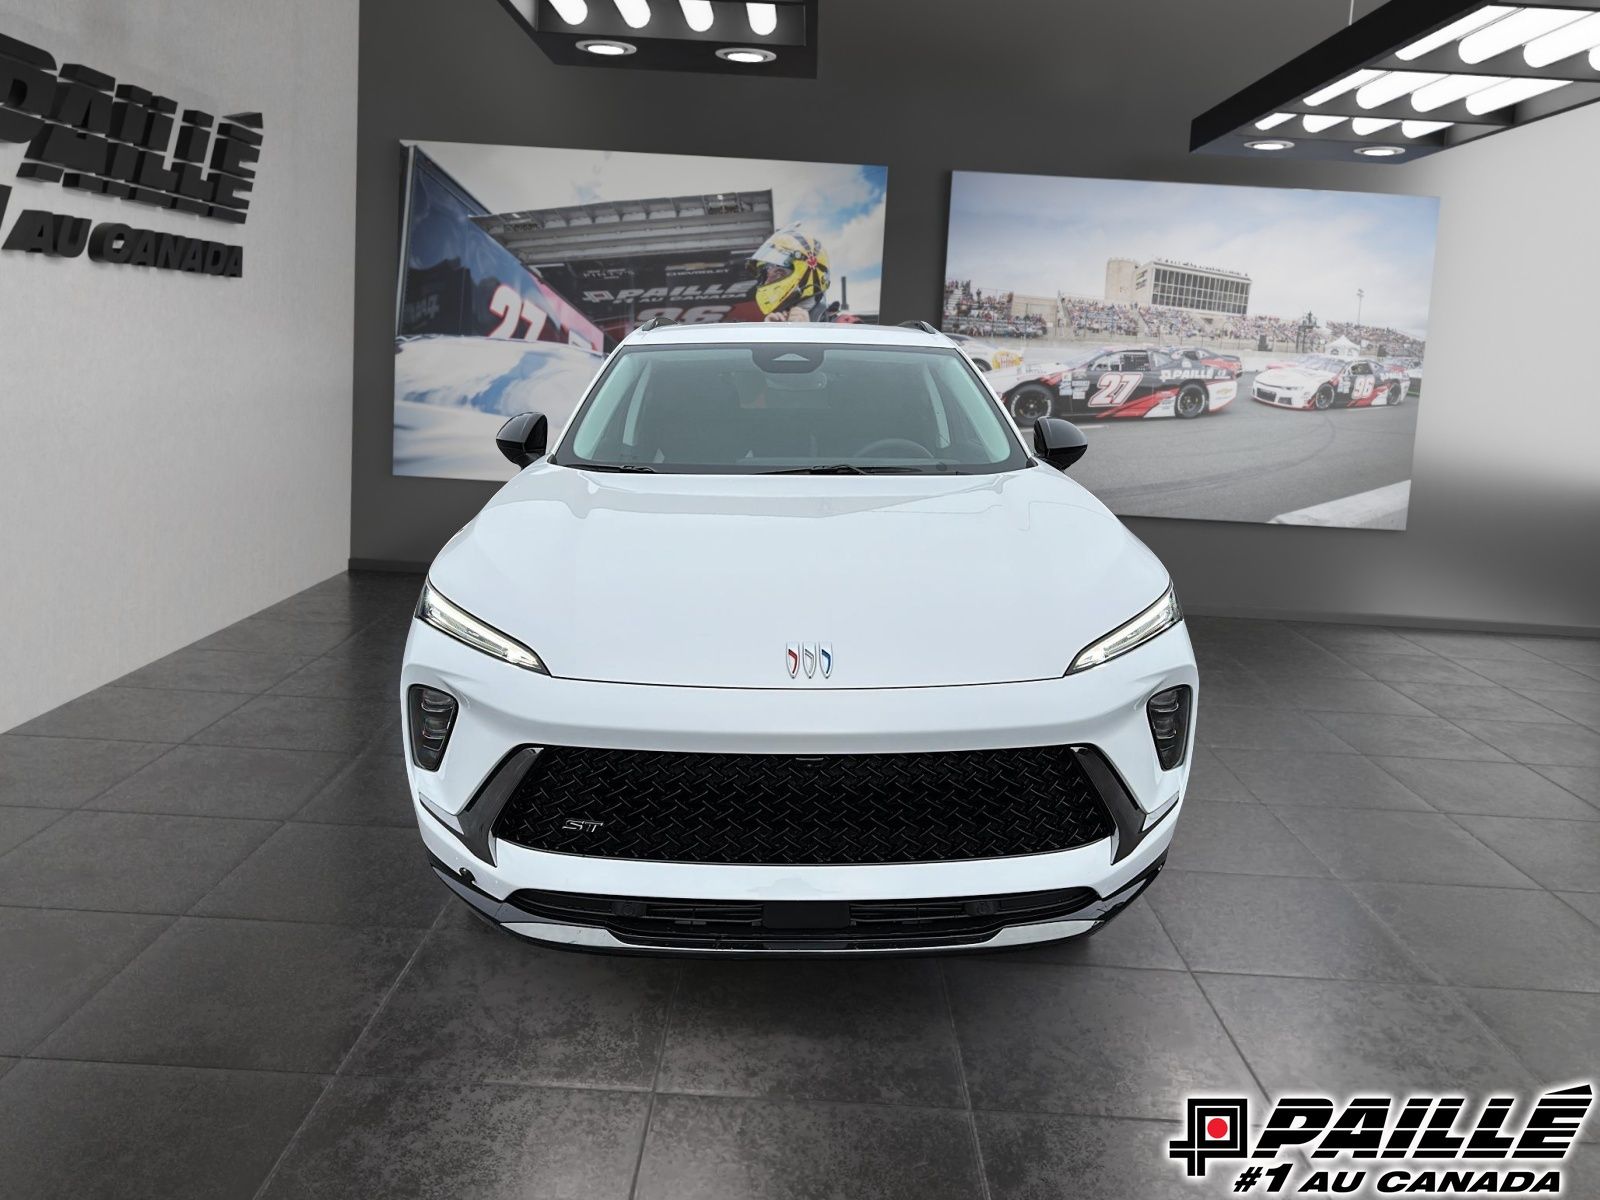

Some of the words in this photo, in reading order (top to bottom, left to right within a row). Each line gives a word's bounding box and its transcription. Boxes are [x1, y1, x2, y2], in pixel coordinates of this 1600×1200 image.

[1, 209, 92, 258] AU
[88, 222, 243, 278] CANADA
[488, 284, 547, 341] 27
[1088, 371, 1144, 407] 27
[562, 818, 604, 833] ST
